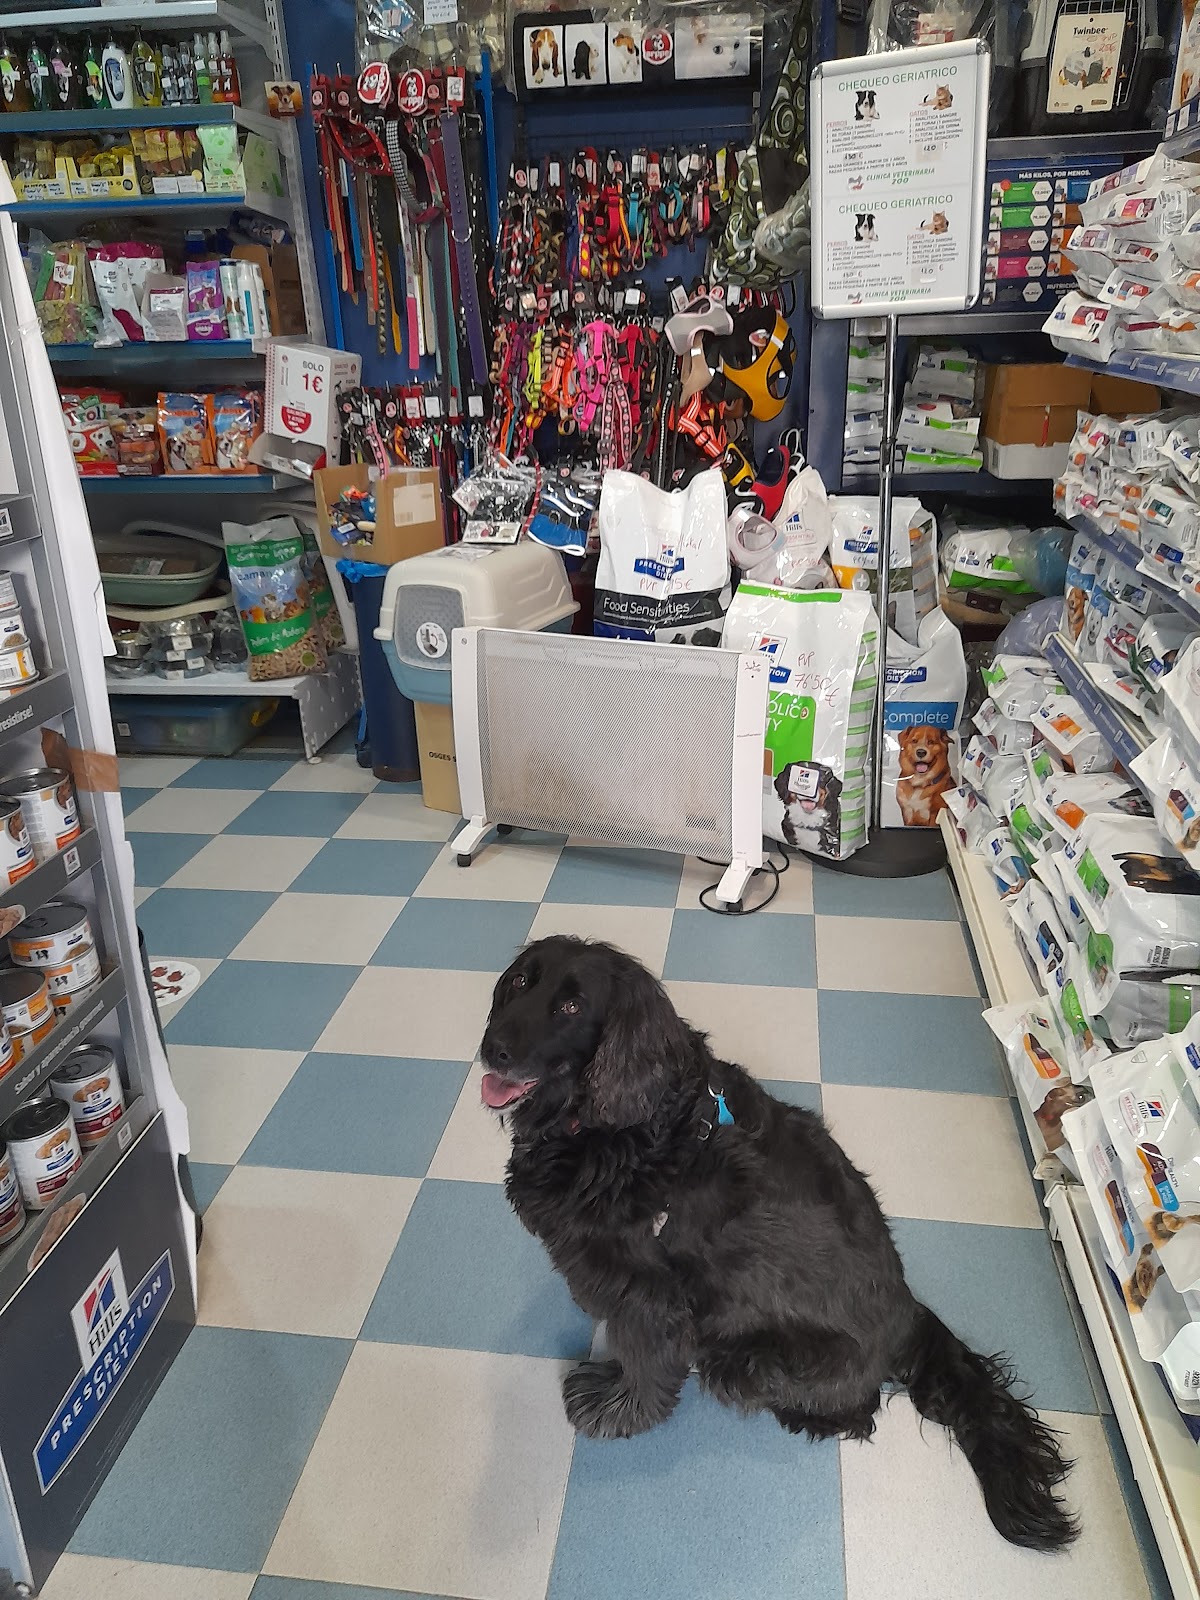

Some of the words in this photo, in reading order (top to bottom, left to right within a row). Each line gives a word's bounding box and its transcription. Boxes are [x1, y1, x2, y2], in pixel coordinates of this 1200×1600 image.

[1073, 26, 1106, 35] Twinbee
[838, 76, 890, 92] CHEQUEO
[892, 66, 958, 84] GERIATRICO
[866, 171, 890, 181] CLINICA
[892, 168, 935, 178] VETERINARIA
[838, 201, 888, 214] CHEQUEO
[890, 195, 953, 209] GERIATRICO
[865, 290, 889, 298] CLINICA
[891, 288, 931, 297] VETERINARIA
[302, 360, 324, 372] SOLO
[302, 373, 324, 394] 1€
[604, 597, 628, 613] Food
[798, 652, 815, 667] PVP
[885, 710, 949, 726] omplete
[1137, 1100, 1148, 1120] Hill's
[88, 1304, 123, 1358] Hill's
[50, 1274, 163, 1452] PRESCRIPTION
[96, 1343, 130, 1402] DIET
